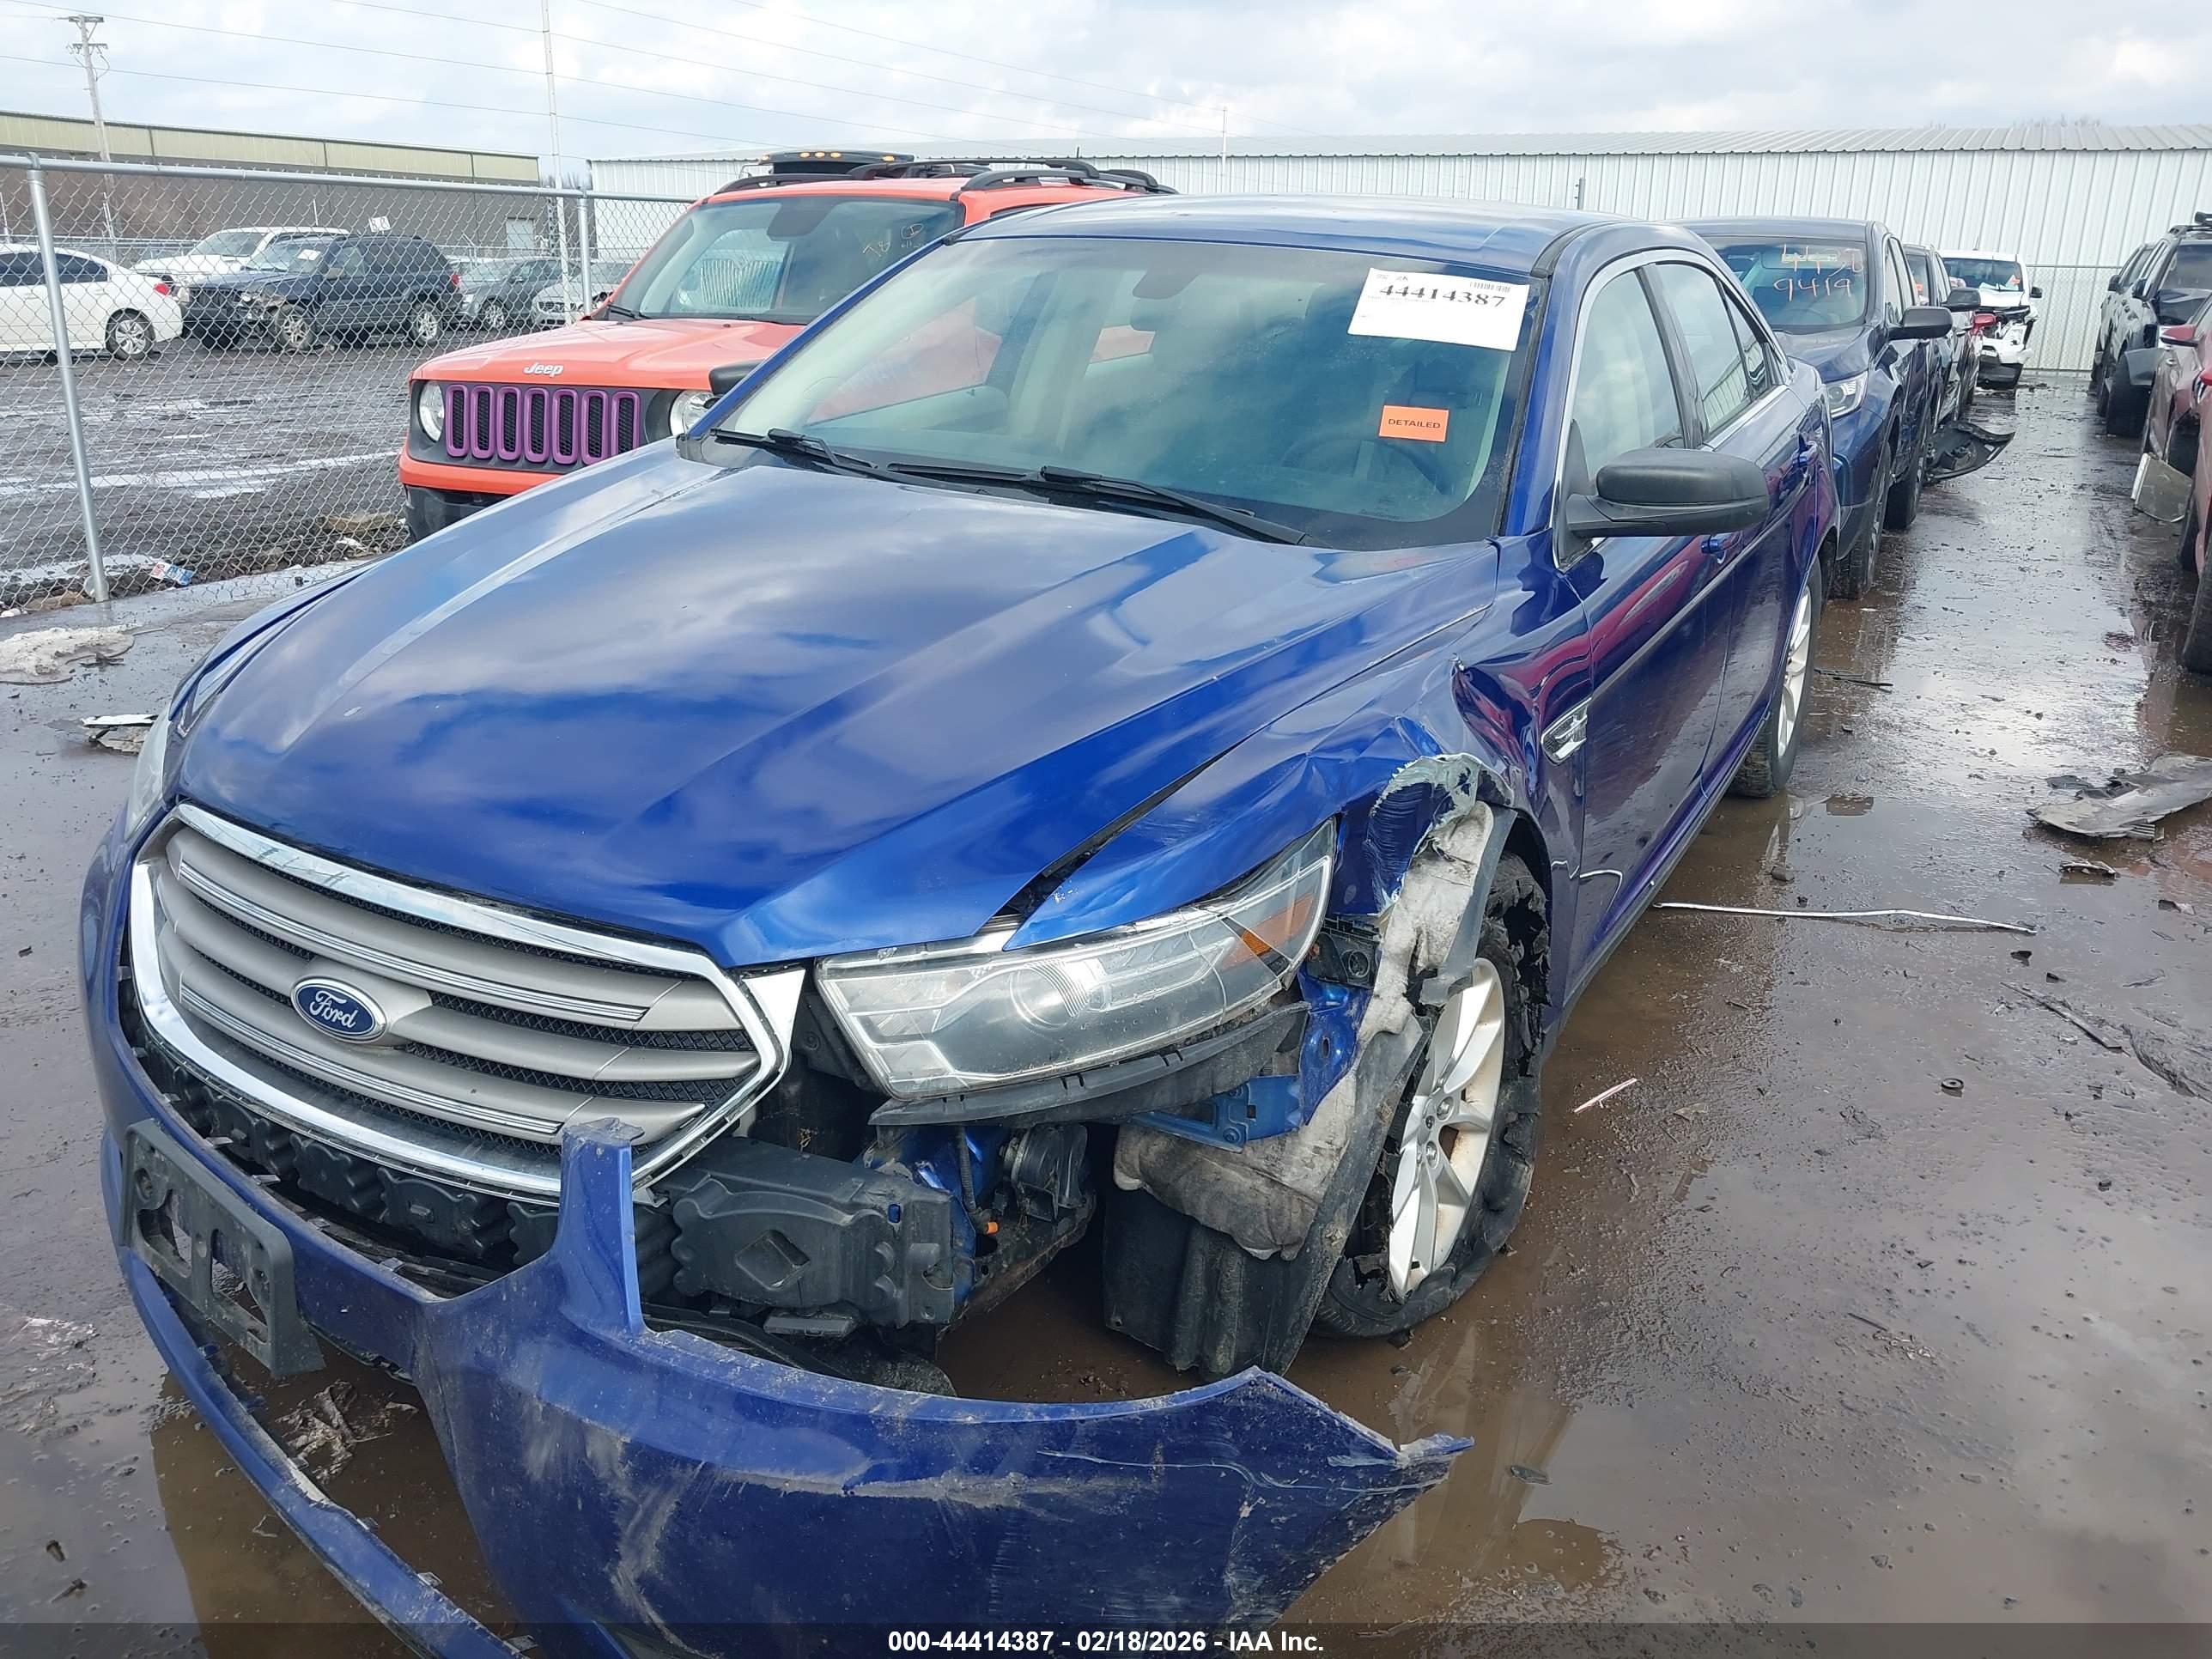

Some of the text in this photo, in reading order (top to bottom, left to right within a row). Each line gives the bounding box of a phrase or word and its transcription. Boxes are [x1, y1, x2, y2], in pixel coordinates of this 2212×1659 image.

[1378, 284, 1507, 307] 44414387
[1773, 277, 1851, 302] 9419
[523, 362, 564, 378] Jeep
[1388, 417, 1441, 429] DETAILED
[309, 990, 358, 1029] Ford
